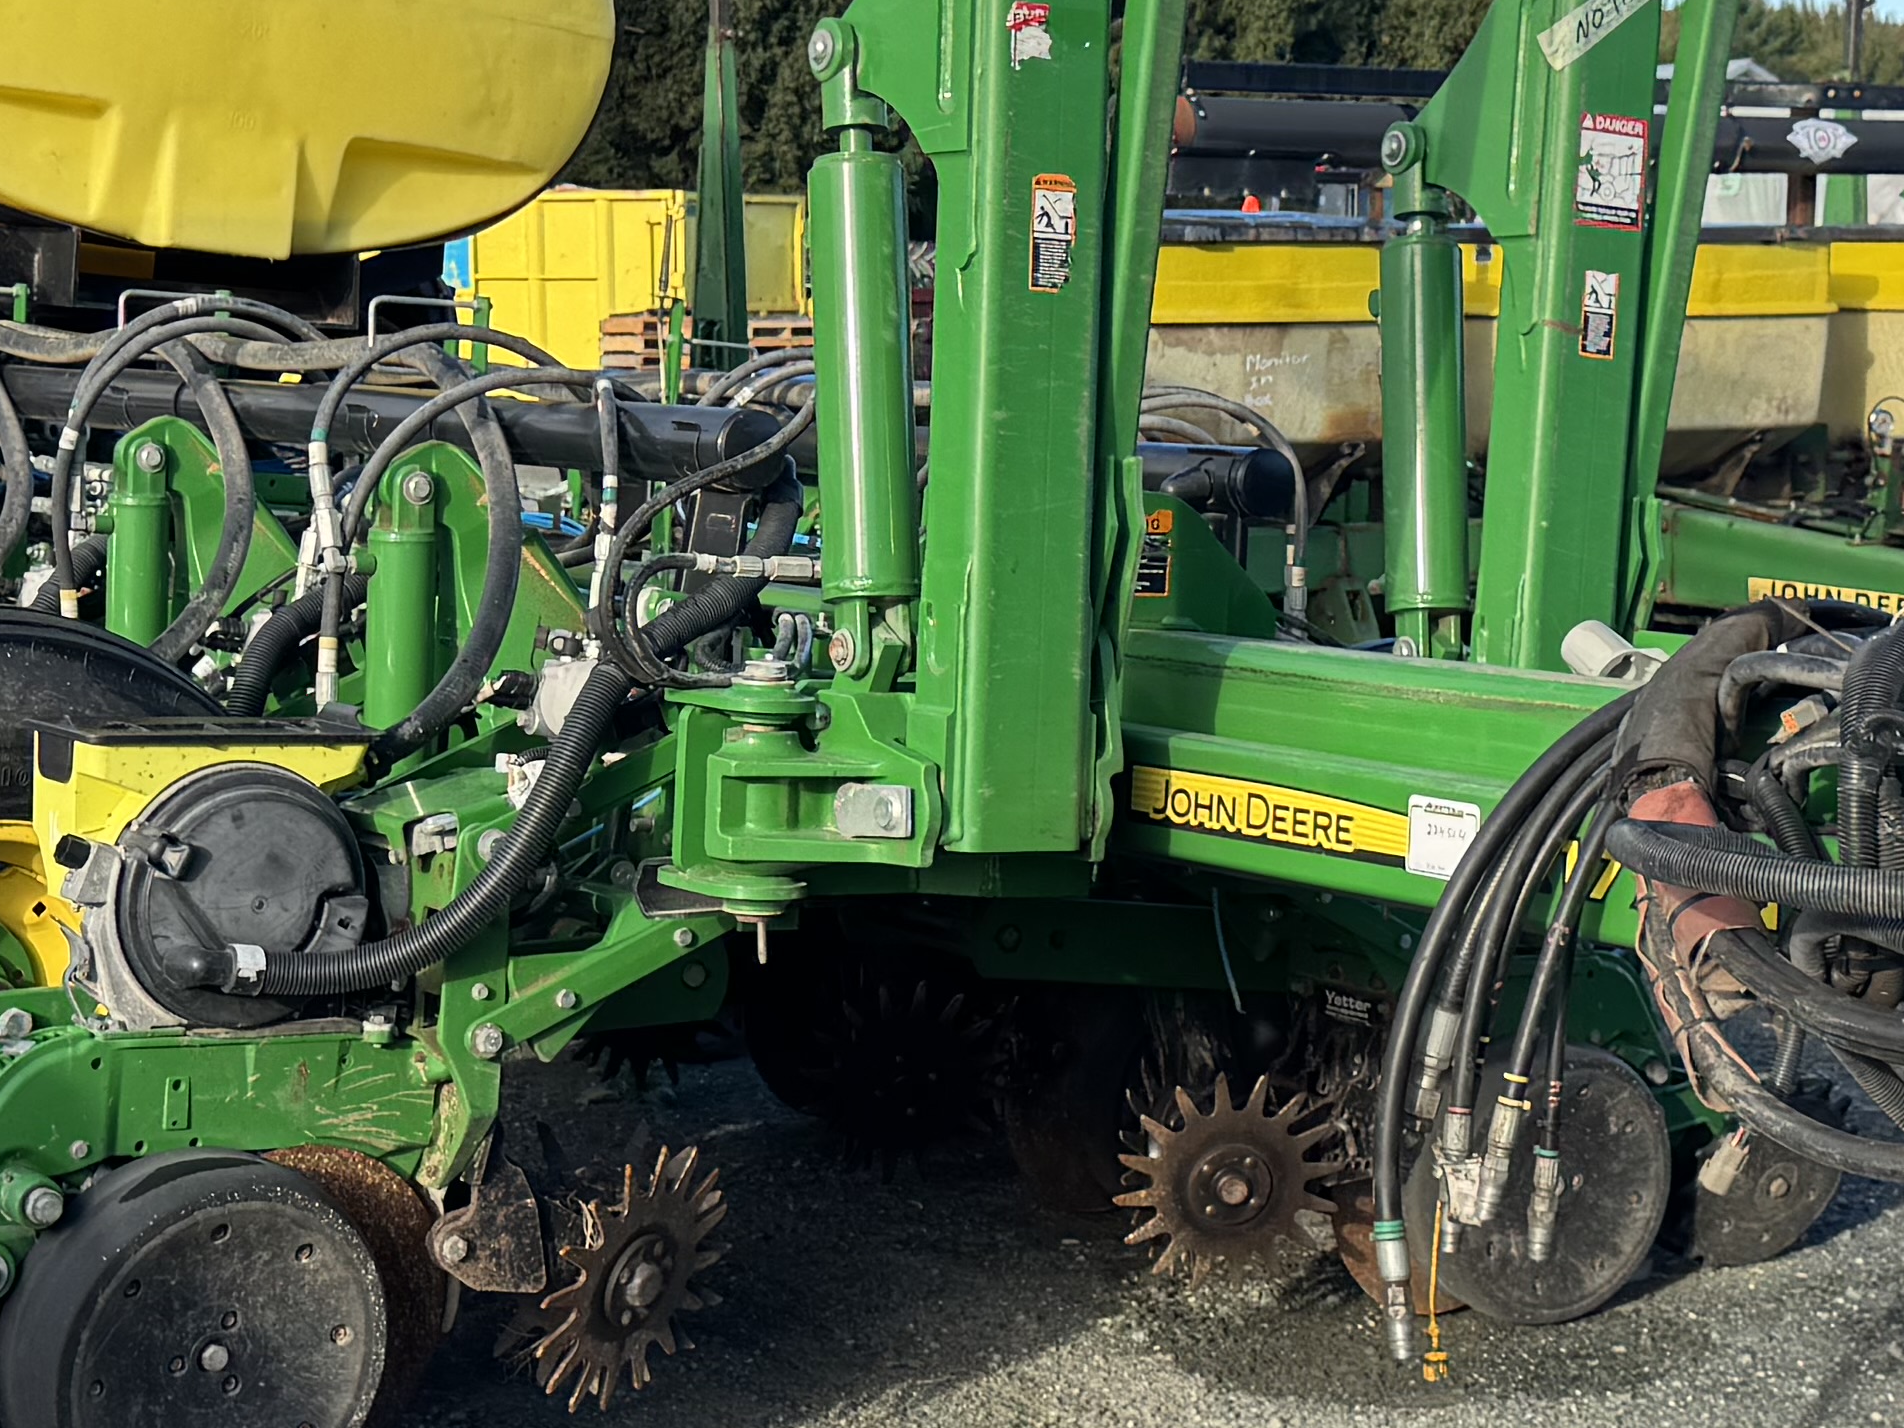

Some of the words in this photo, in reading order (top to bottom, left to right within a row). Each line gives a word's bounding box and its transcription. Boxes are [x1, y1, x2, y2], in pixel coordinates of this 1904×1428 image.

[1576, 8, 1604, 44] NO
[1596, 115, 1644, 137] DANGER
[1152, 778, 1237, 829] JOHN
[1246, 792, 1355, 846] DEERE
